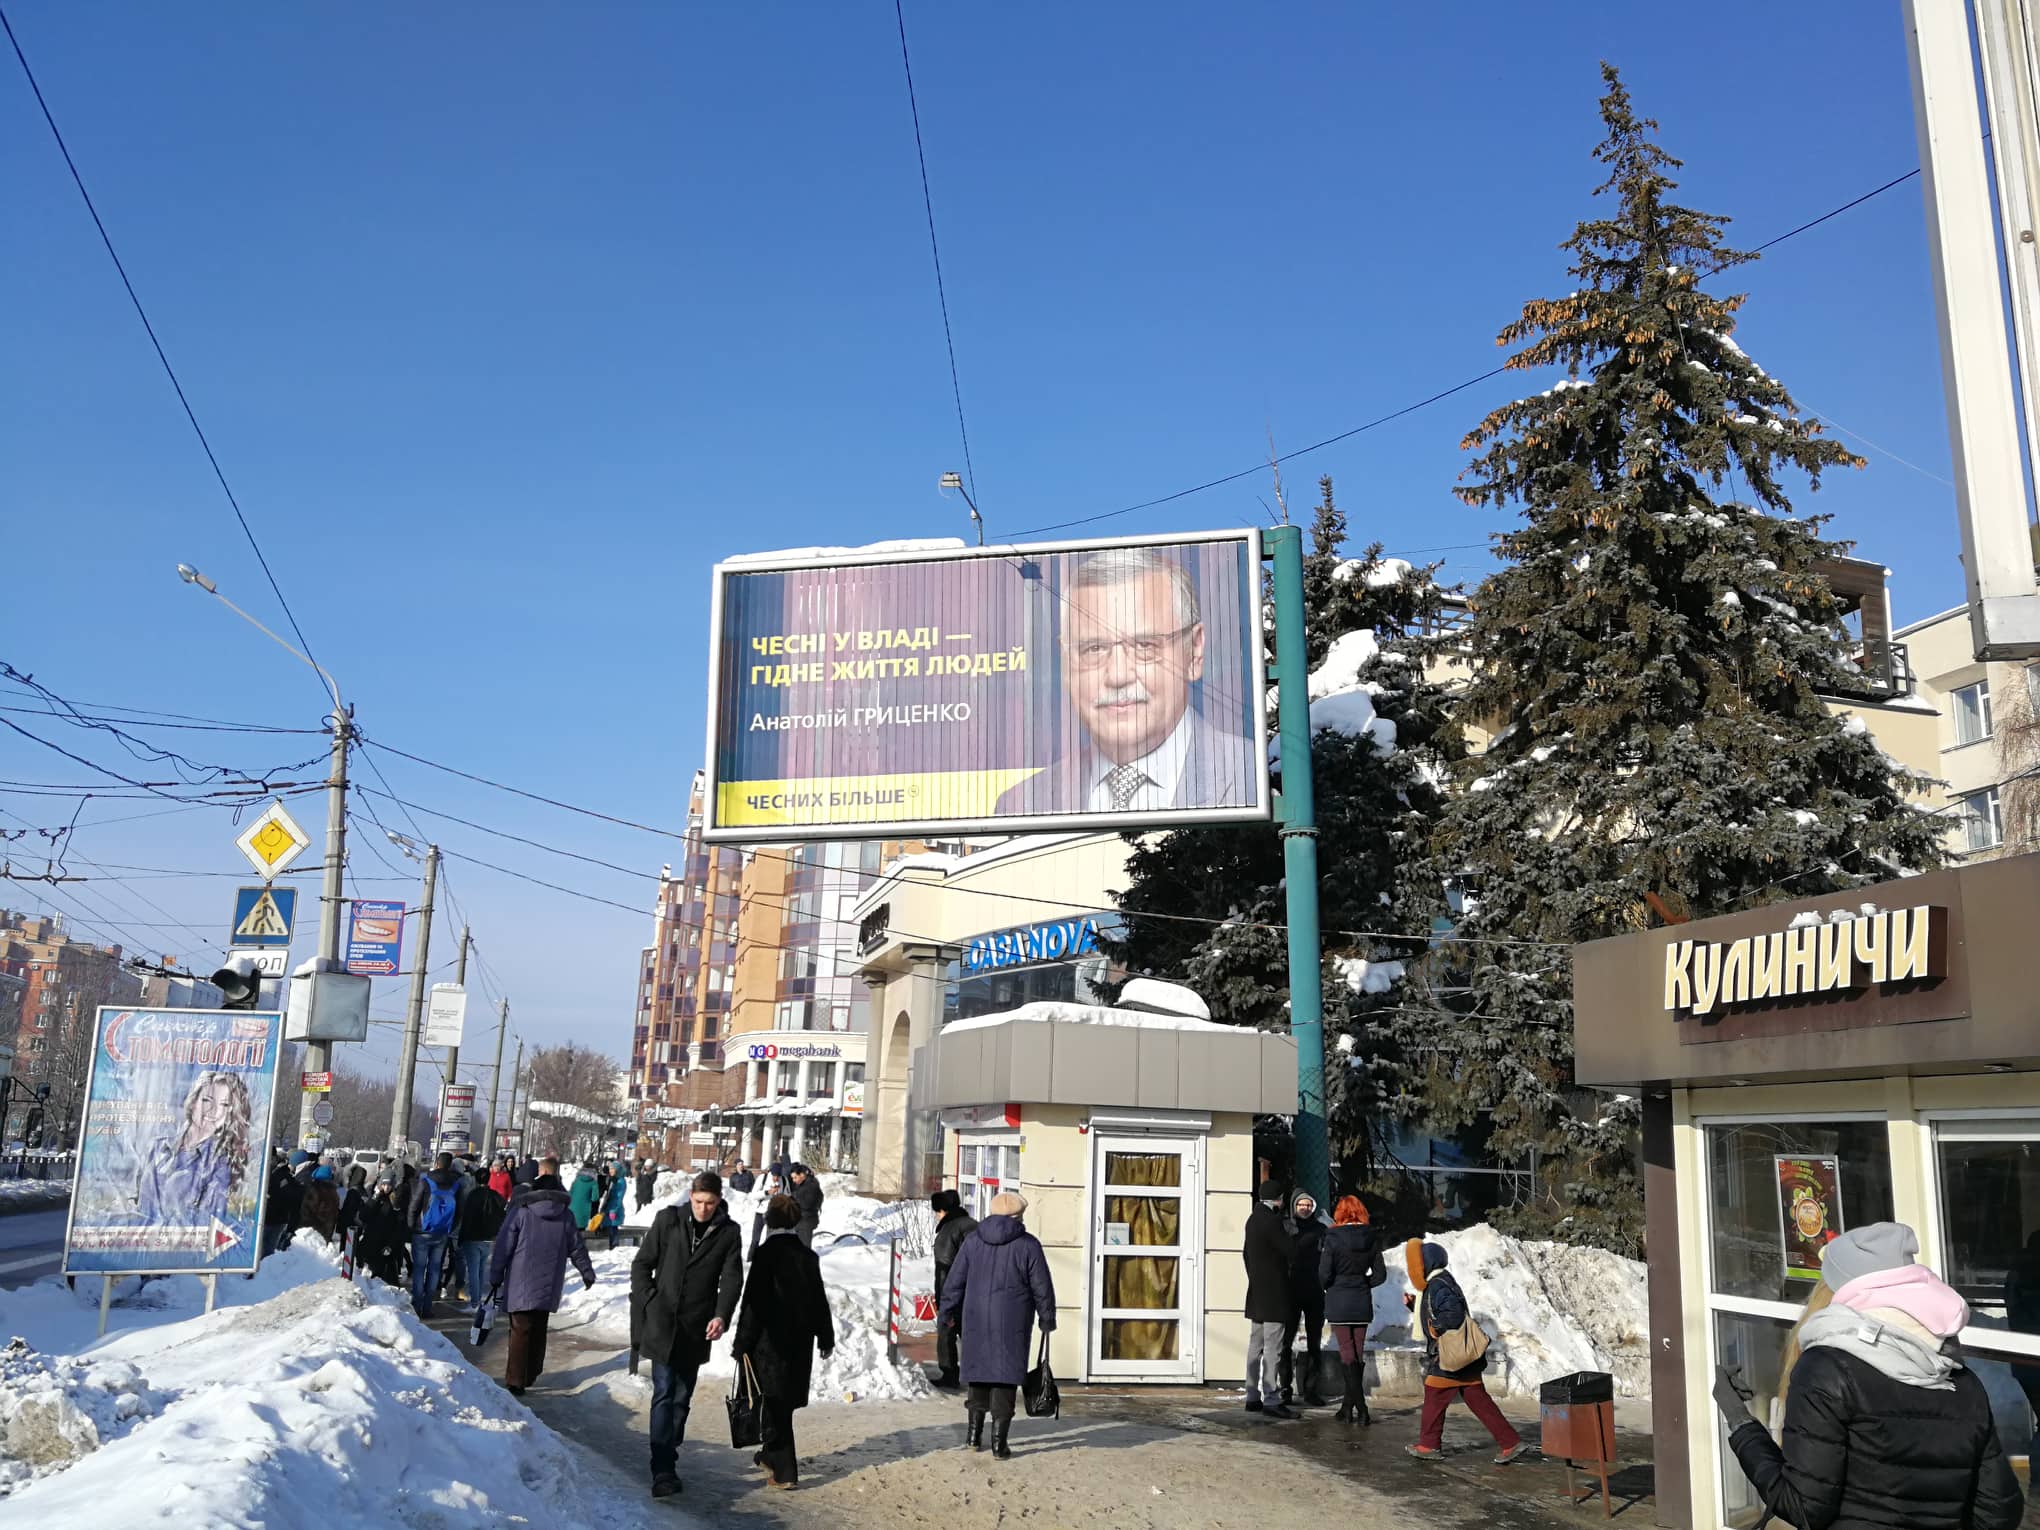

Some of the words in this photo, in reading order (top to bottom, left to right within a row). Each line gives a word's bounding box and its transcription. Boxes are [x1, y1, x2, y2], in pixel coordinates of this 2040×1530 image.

[752, 633, 826, 656] ЧЕСНІ
[834, 632, 850, 652] У
[858, 627, 939, 650] ВЛАДІ
[751, 662, 825, 687] ГІДНЕ
[830, 657, 919, 681] ЖИТТЯ
[925, 646, 1027, 677] ЛЮДЕЙ
[749, 708, 847, 732] Анатолій
[854, 702, 972, 728] ГРИЦЕНКО
[747, 792, 824, 810] ЧЕСНИХ
[830, 788, 905, 807] БІЛЬШЕ
[969, 919, 1100, 971] CASANOVA
